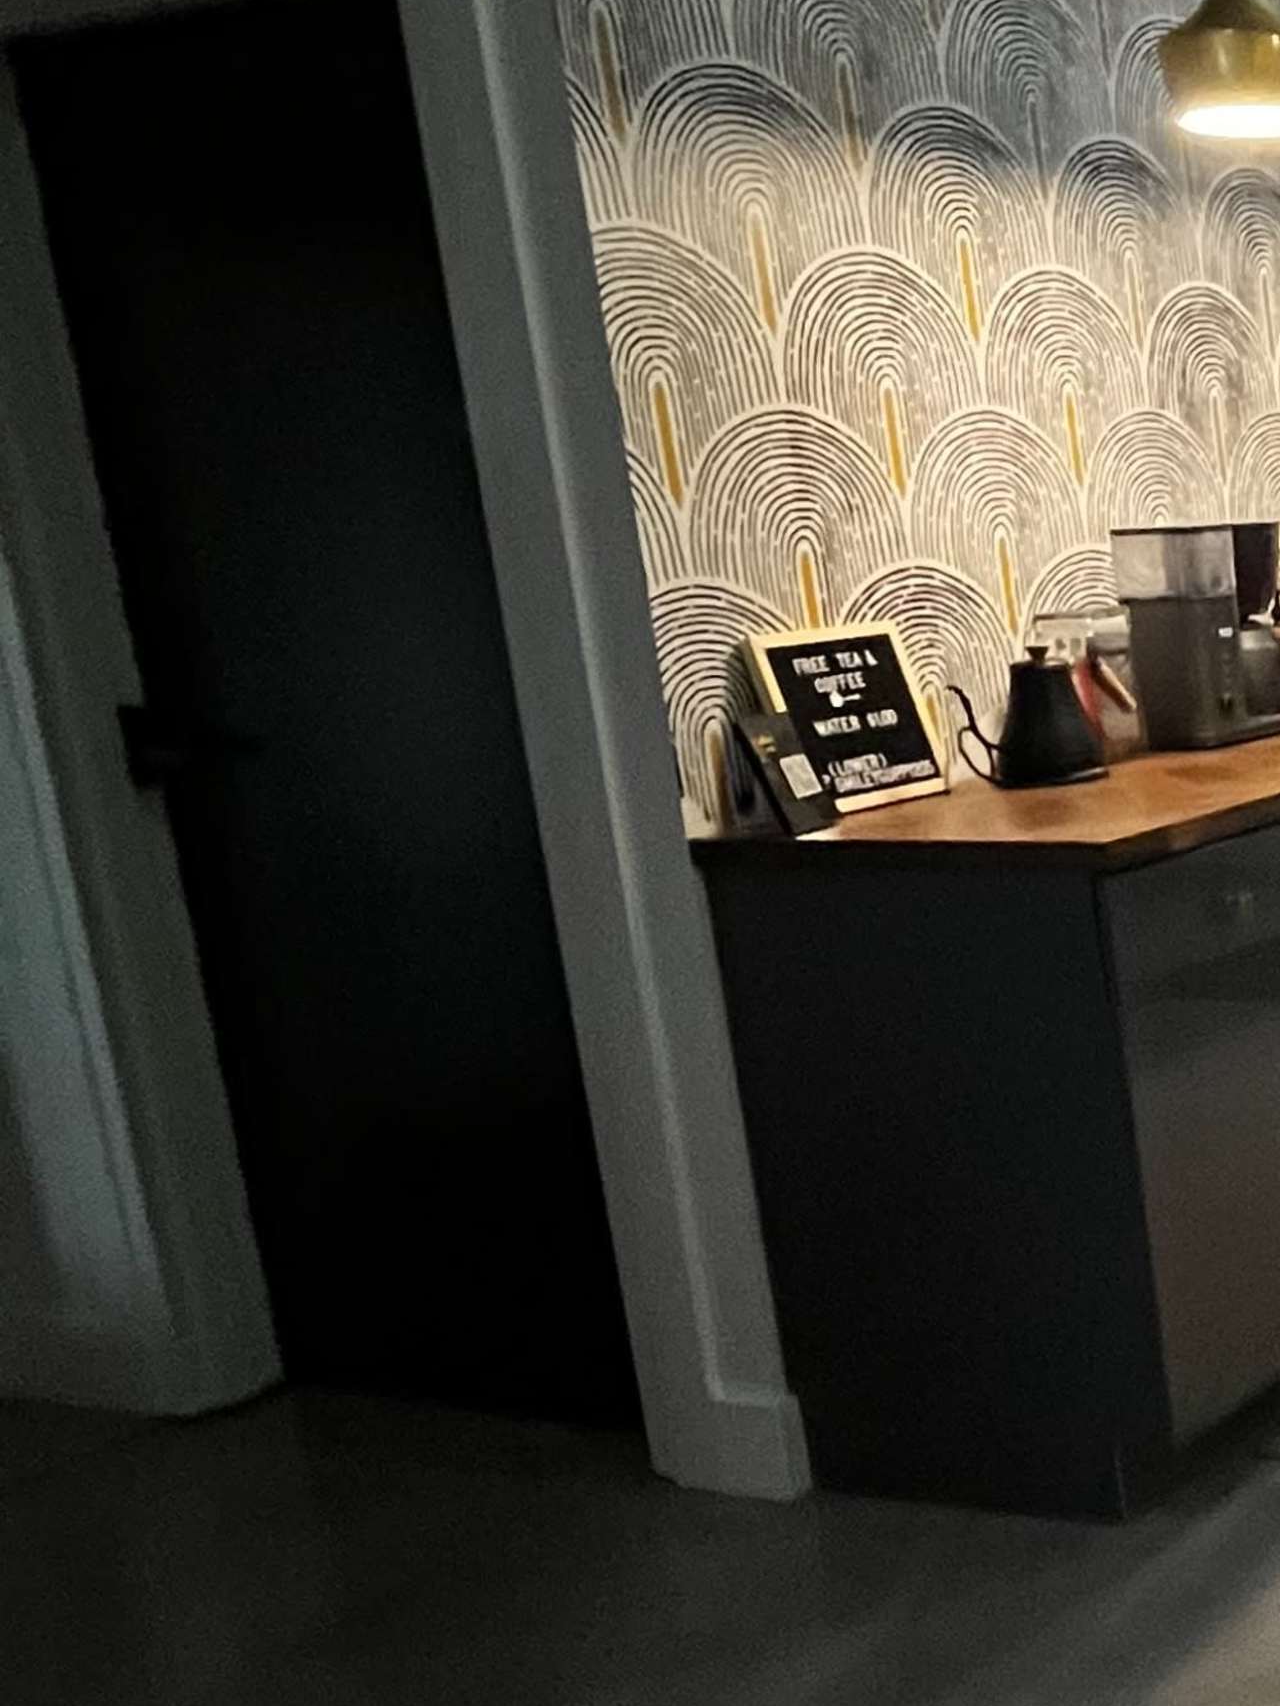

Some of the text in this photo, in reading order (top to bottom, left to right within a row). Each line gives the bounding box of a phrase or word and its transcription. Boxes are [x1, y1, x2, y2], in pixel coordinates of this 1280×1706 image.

[792, 655, 831, 675] FREE
[835, 651, 863, 668] TEA
[814, 714, 861, 736] WATER
